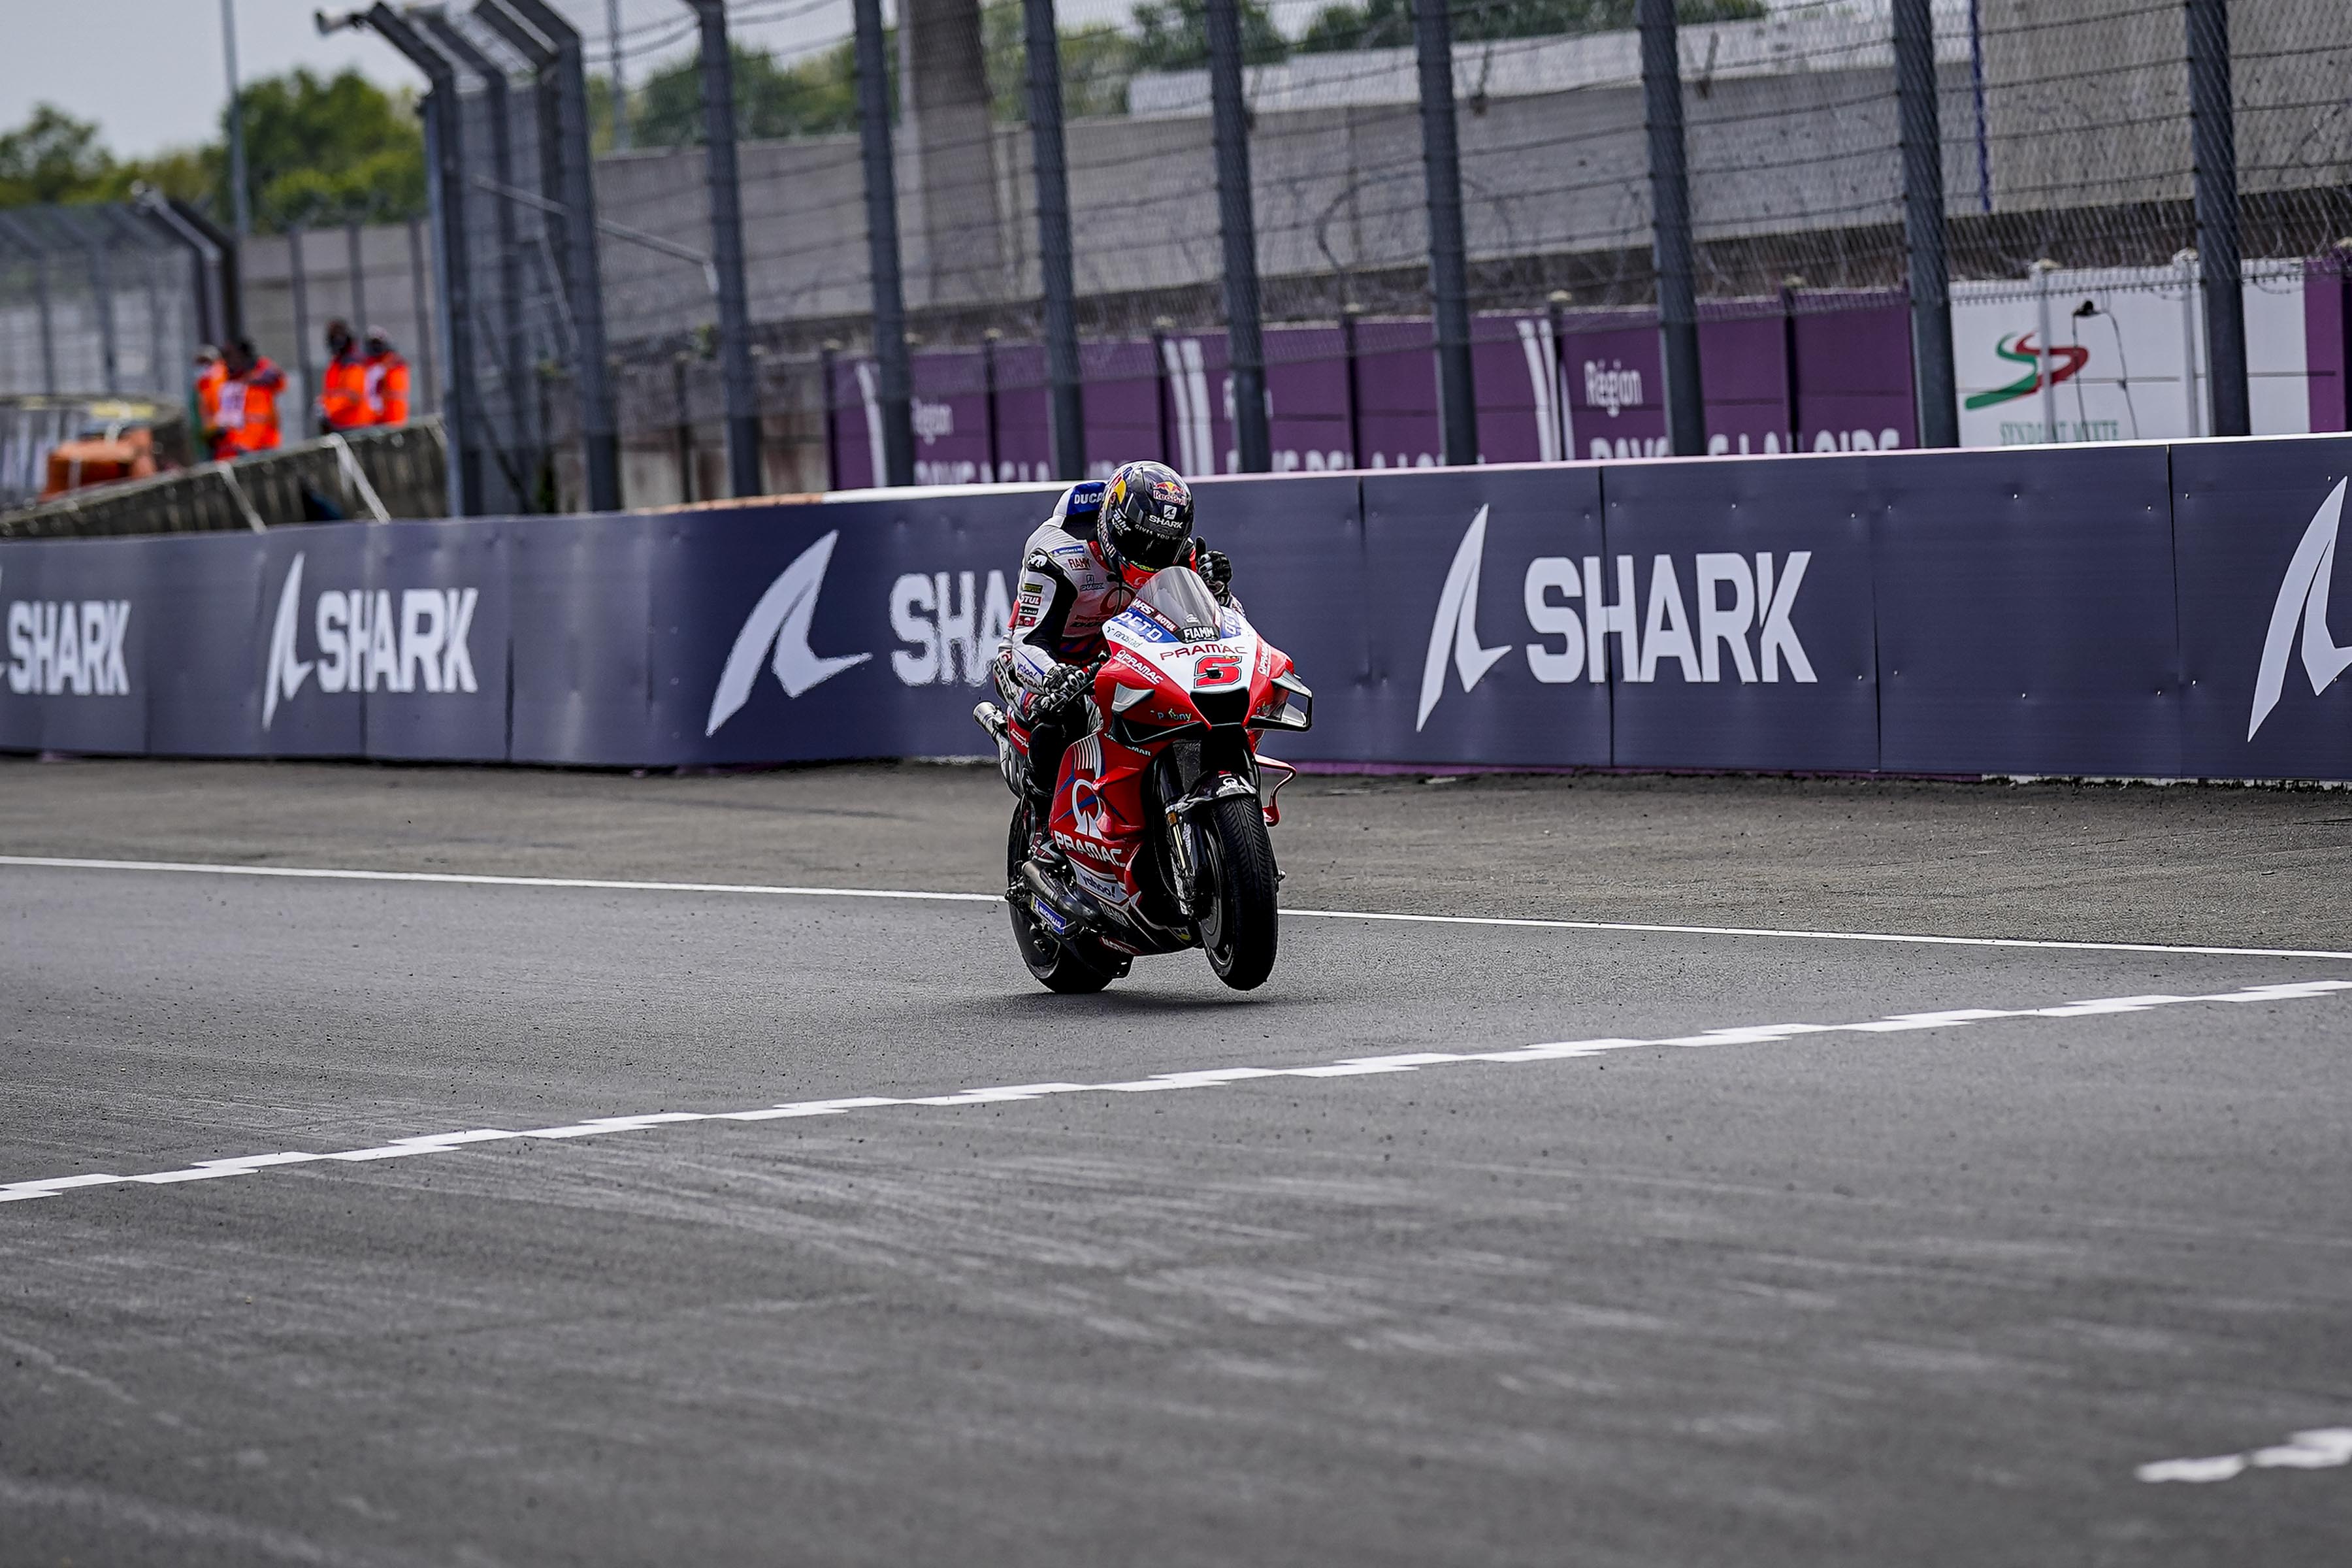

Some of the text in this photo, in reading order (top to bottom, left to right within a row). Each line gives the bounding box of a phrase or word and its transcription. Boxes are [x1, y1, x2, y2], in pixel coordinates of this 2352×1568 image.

[1074, 492, 1103, 504] DUCA
[1149, 514, 1183, 529] SHARK
[1021, 596, 1039, 604] OTUL
[889, 570, 1012, 686] SHA
[1119, 612, 1163, 642] OCTO
[1154, 613, 1176, 632] MOTUL
[1525, 551, 1818, 683] SHARK
[317, 587, 478, 694] SHARK
[1184, 627, 1215, 639] FIAMM
[8, 600, 129, 695] SHARK
[1160, 643, 1248, 661] PRAMAC
[1122, 651, 1164, 683] PRAMAC
[1054, 830, 1122, 866] PRAMAC
[1080, 873, 1116, 898] yahoo!
